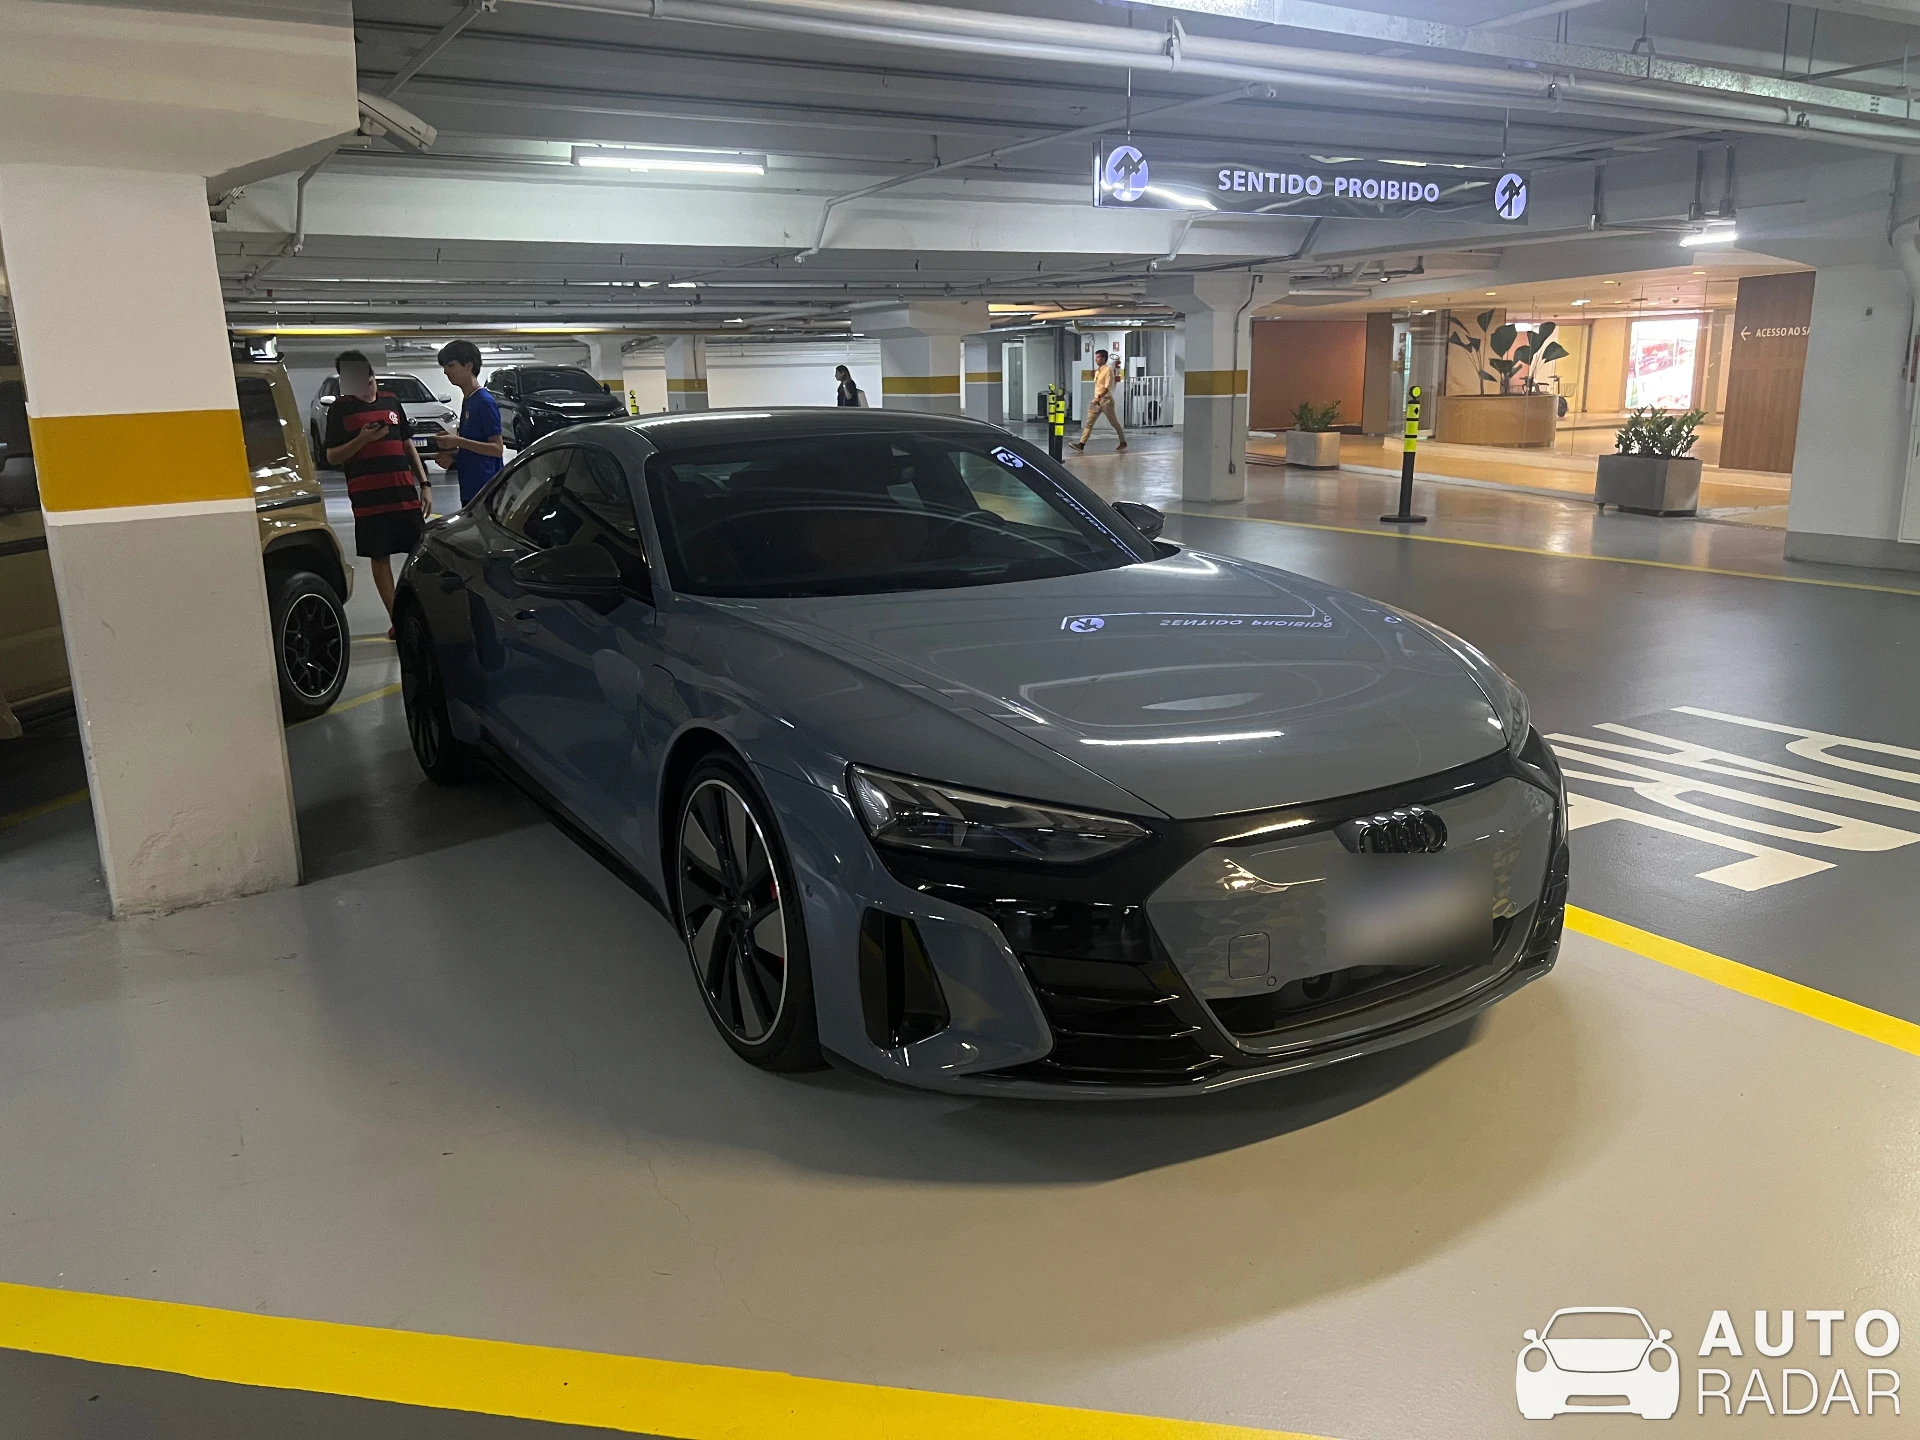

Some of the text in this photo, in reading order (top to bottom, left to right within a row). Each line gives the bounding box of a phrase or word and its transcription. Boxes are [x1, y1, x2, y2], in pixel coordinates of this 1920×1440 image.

[1218, 169, 1440, 203] SENTIDO PROIBIDO
[1755, 327, 1787, 338] ACESSO
[1787, 326, 1801, 337] AO
